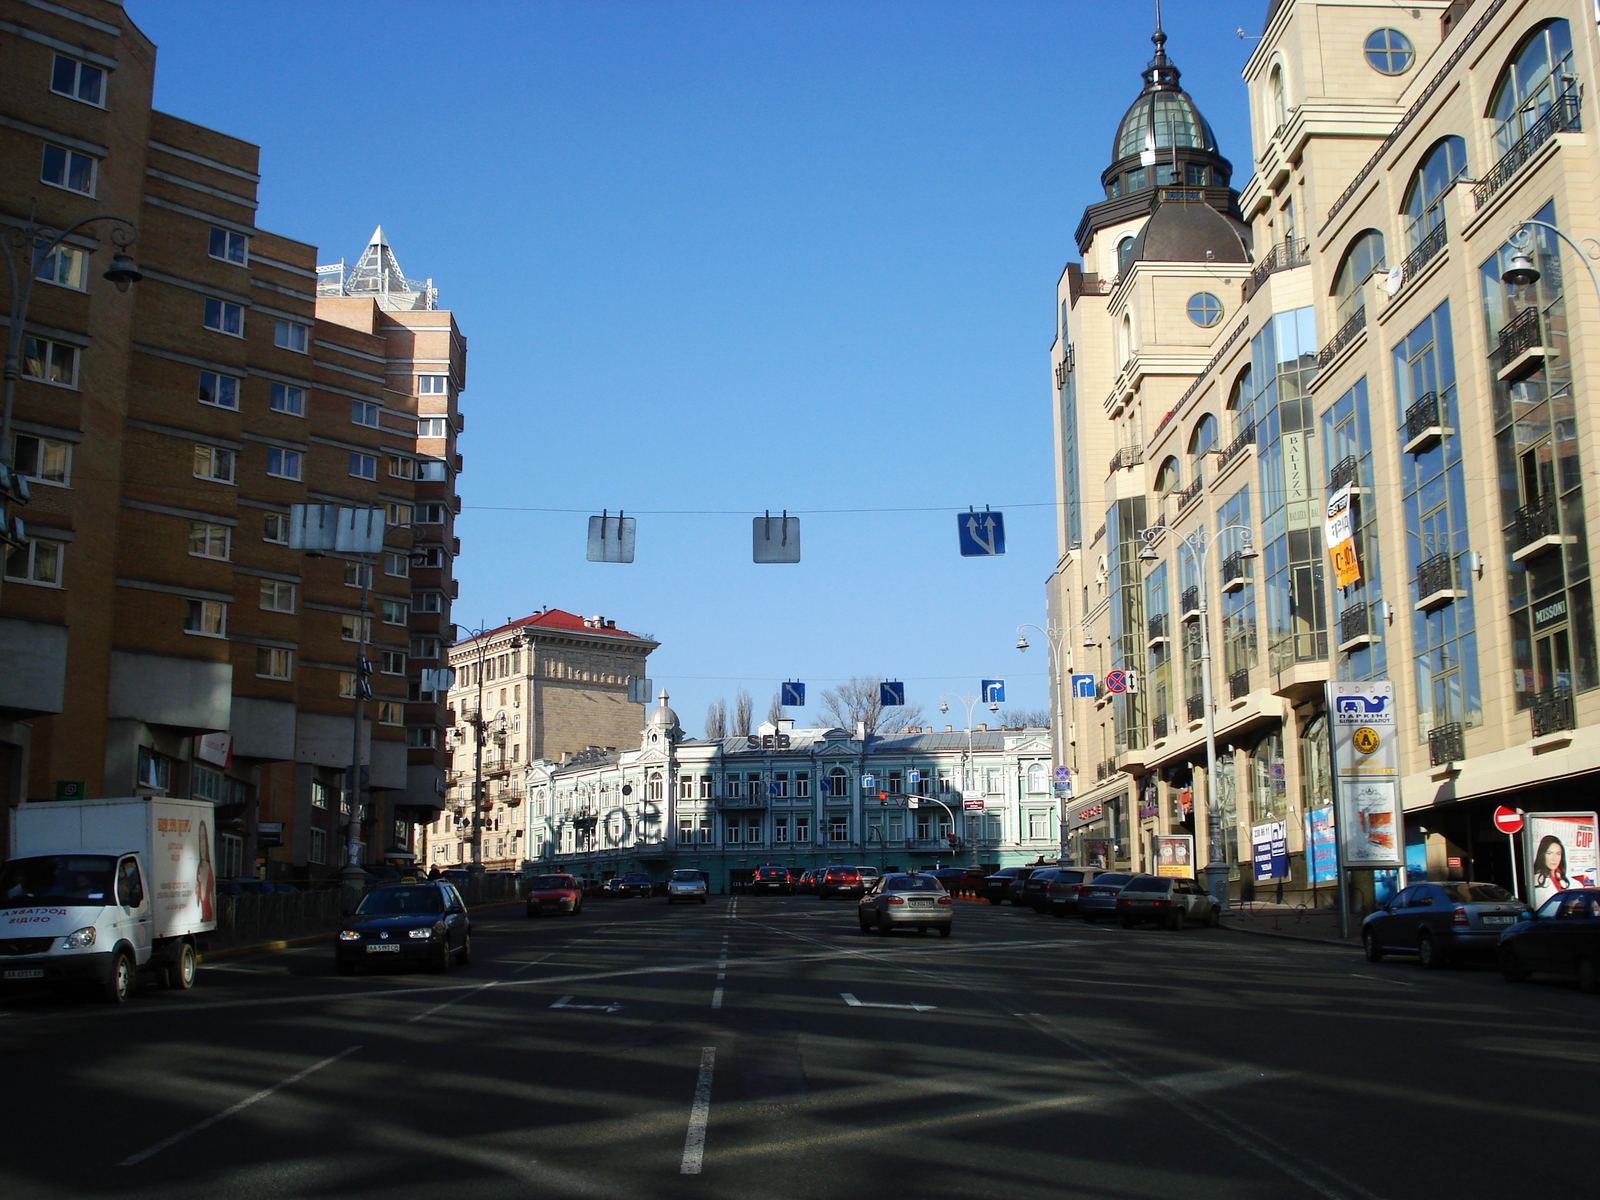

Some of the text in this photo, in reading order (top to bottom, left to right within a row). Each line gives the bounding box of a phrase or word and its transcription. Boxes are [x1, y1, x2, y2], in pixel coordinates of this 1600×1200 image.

[1290, 437, 1302, 497] BALIZZA
[1535, 600, 1566, 624] MISSONI
[747, 734, 791, 749] SEB
[1576, 831, 1593, 848] CUP
